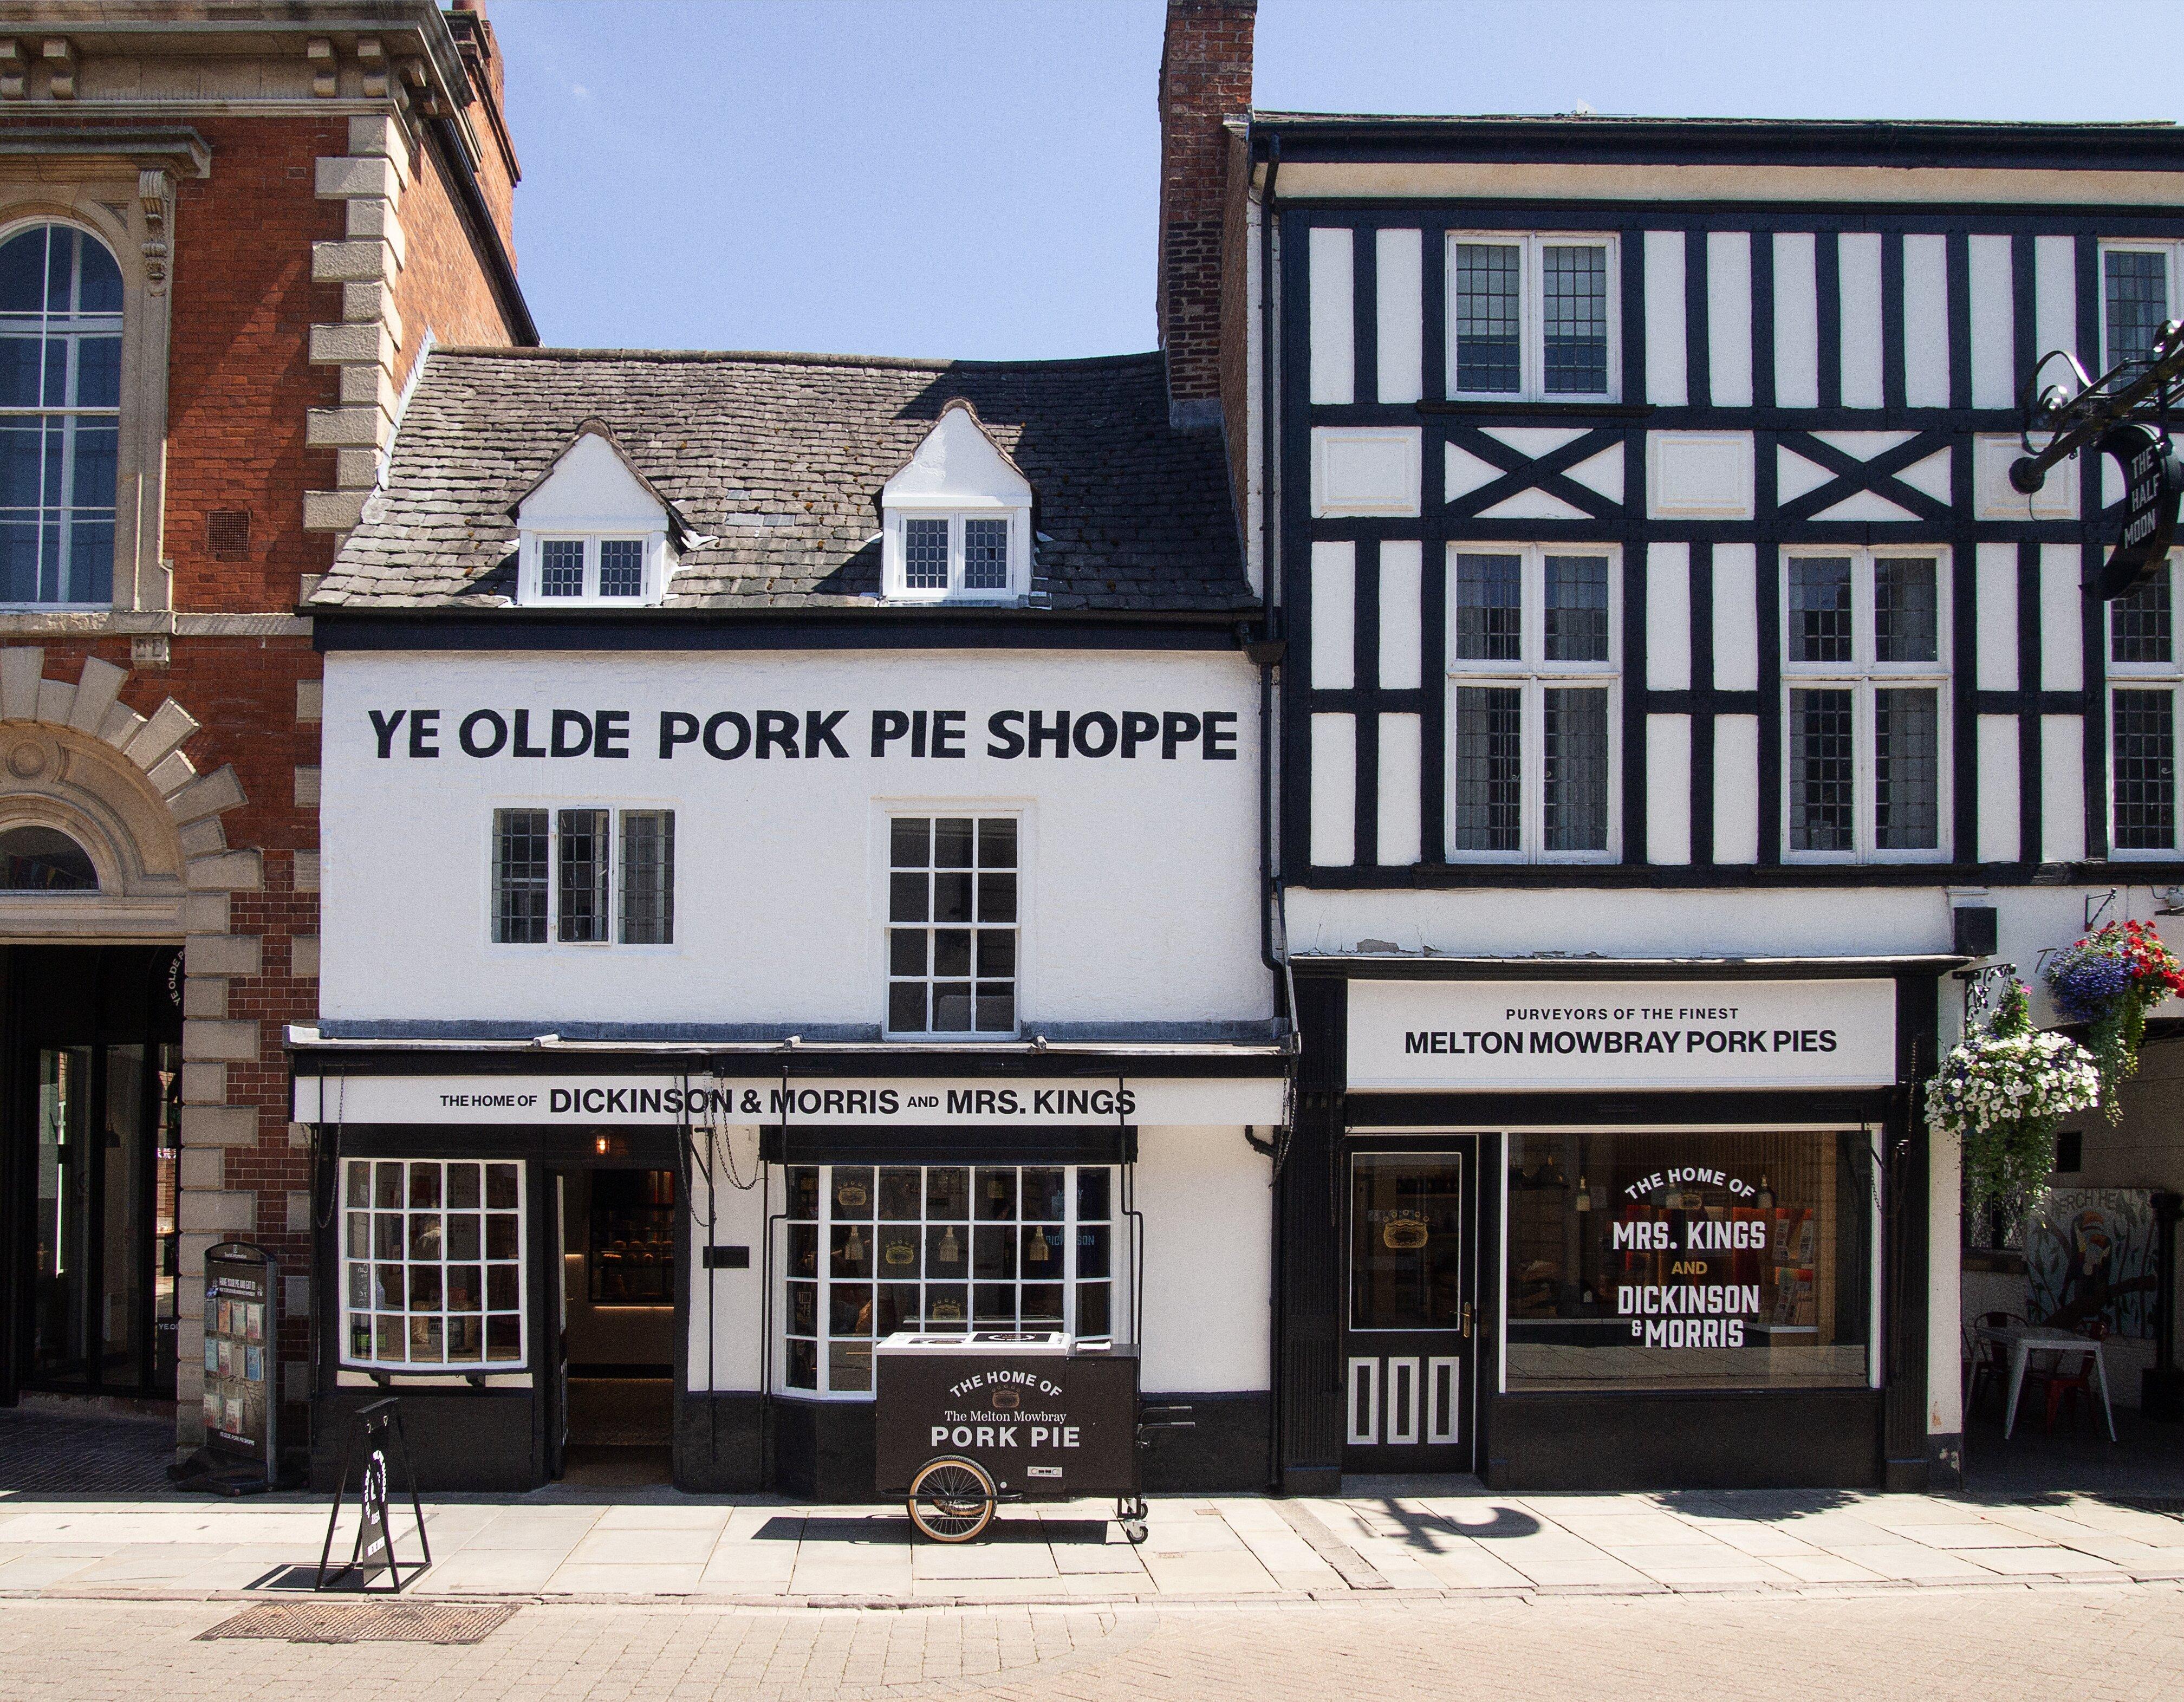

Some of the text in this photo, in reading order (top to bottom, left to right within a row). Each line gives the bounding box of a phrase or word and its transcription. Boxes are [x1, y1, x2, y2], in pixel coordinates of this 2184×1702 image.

[2131, 445, 2154, 479] THE
[2131, 472, 2160, 512] HALF
[2124, 508, 2156, 549] MOON
[368, 709, 1238, 761] YE OLDE PORK PIE SHOPPE
[168, 958, 180, 990] OLDE
[171, 990, 180, 1006] YE
[1506, 1008, 1739, 1021] PURVEYORS OF THE FINEST
[1405, 1029, 1837, 1054] MELTON MOWBRAY PORK PIES
[440, 1088, 1136, 1115] THE HOME OF DICKINSON & MORRIS AND MRS. KINGS
[1625, 1167, 1756, 1200] THE HOME OF
[1613, 1221, 1678, 1250] MRS.
[1687, 1221, 1766, 1250] KINGS
[1672, 1261, 1707, 1274] AND
[1618, 1285, 1759, 1314] DICKINSON
[950, 1370, 1062, 1398] THE HOME OF
[944, 1410, 1067, 1425] The Melton Mowbray
[931, 1426, 1080, 1447] PORK PIE
